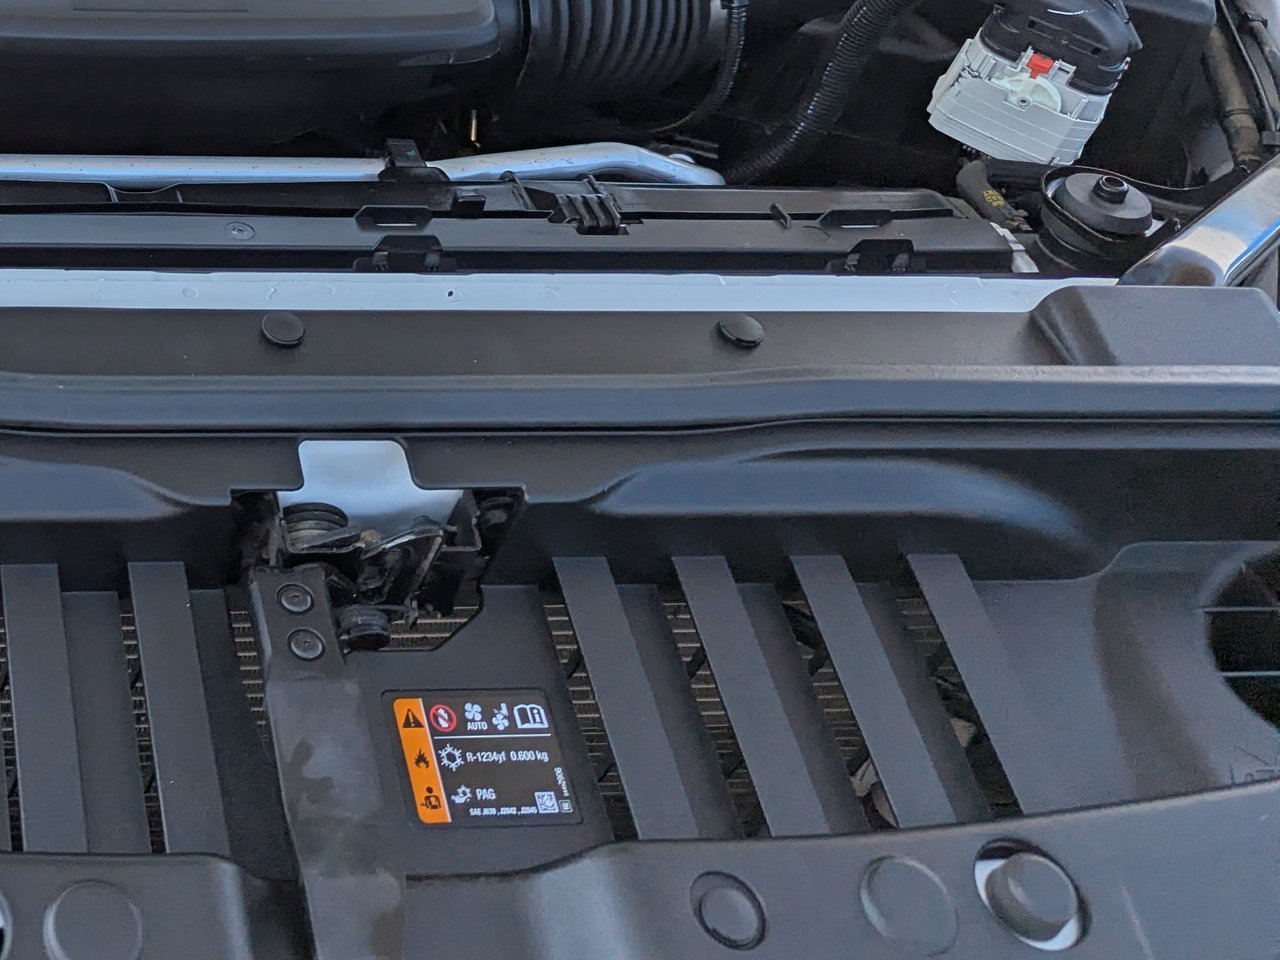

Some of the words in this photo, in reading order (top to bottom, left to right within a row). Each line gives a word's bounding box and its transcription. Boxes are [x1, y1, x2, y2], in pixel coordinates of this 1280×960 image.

[467, 721, 488, 731] AUTO
[466, 751, 506, 763] R-1234yf
[510, 751, 535, 762] 0.600
[535, 751, 549, 762] kg
[476, 788, 496, 800] PAG
